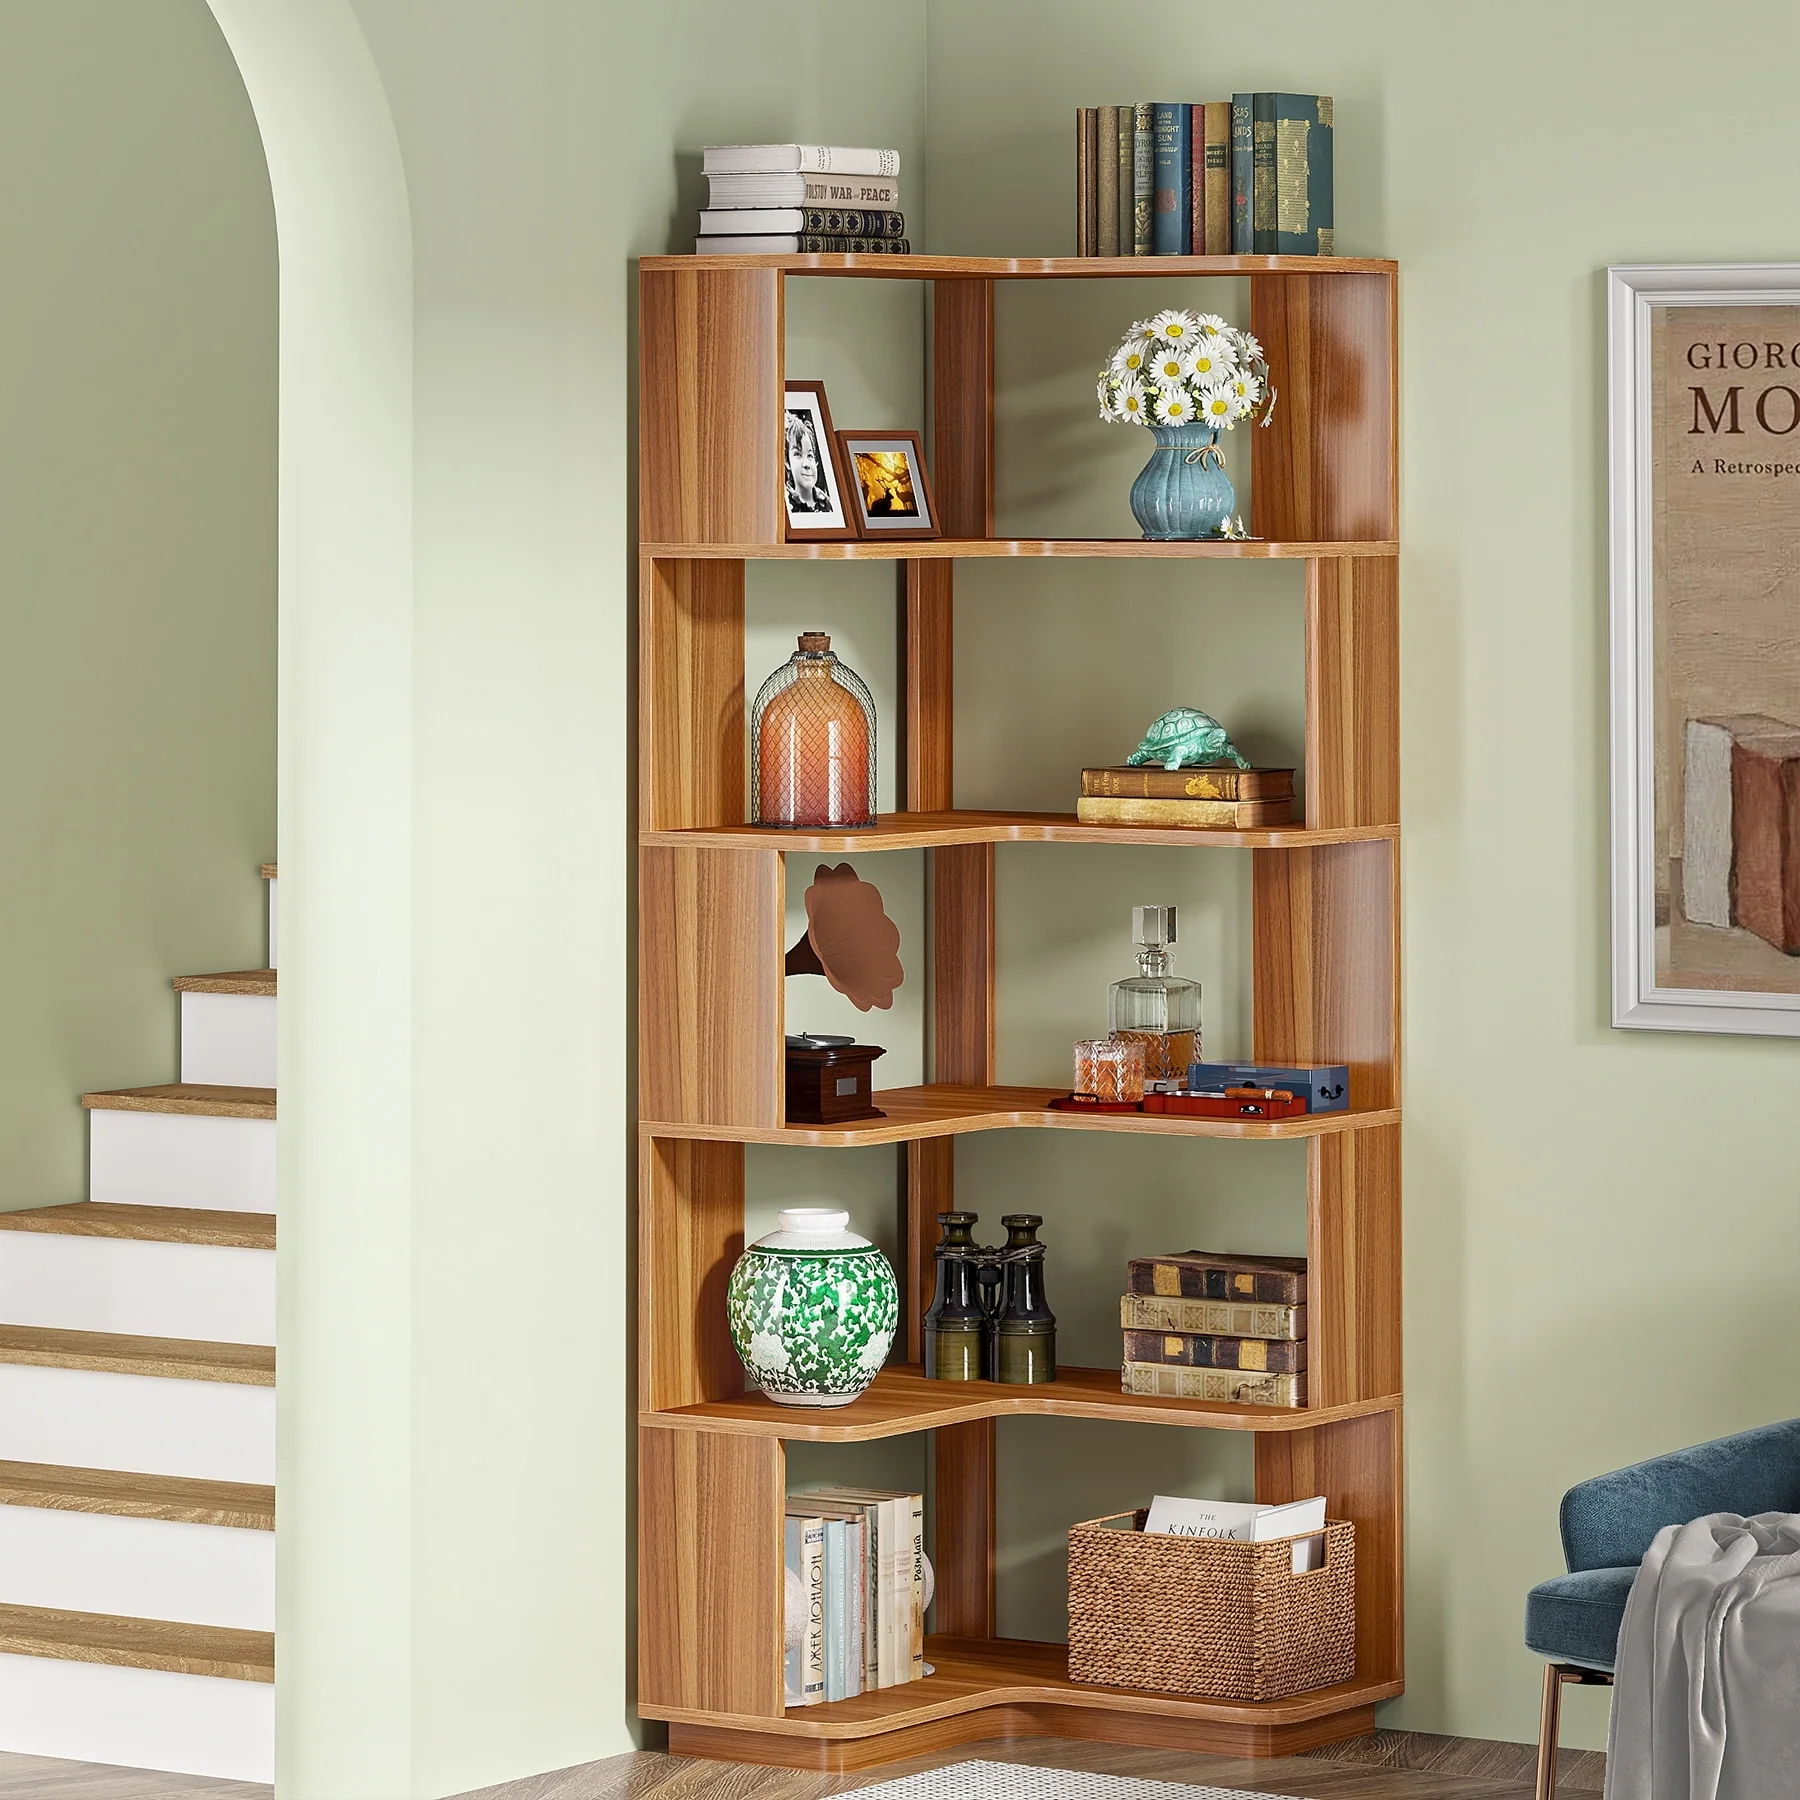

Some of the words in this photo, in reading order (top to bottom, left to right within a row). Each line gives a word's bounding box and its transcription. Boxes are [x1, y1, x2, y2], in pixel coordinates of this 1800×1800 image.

[1157, 111, 1173, 119] LAND
[1233, 105, 1249, 119] SEAS
[1157, 134, 1173, 142] SUN
[806, 184, 828, 200] TOLSTOY
[830, 186, 852, 200] WAR
[860, 187, 891, 202] PEACE
[1687, 385, 1800, 435] MO
[1691, 459, 1705, 474] A
[1199, 1513, 1217, 1522] THE
[1168, 1523, 1238, 1540] KINFOLK
[810, 1552, 823, 1625] ЛОНДОН
[810, 1630, 823, 1672] ДЖЕК
